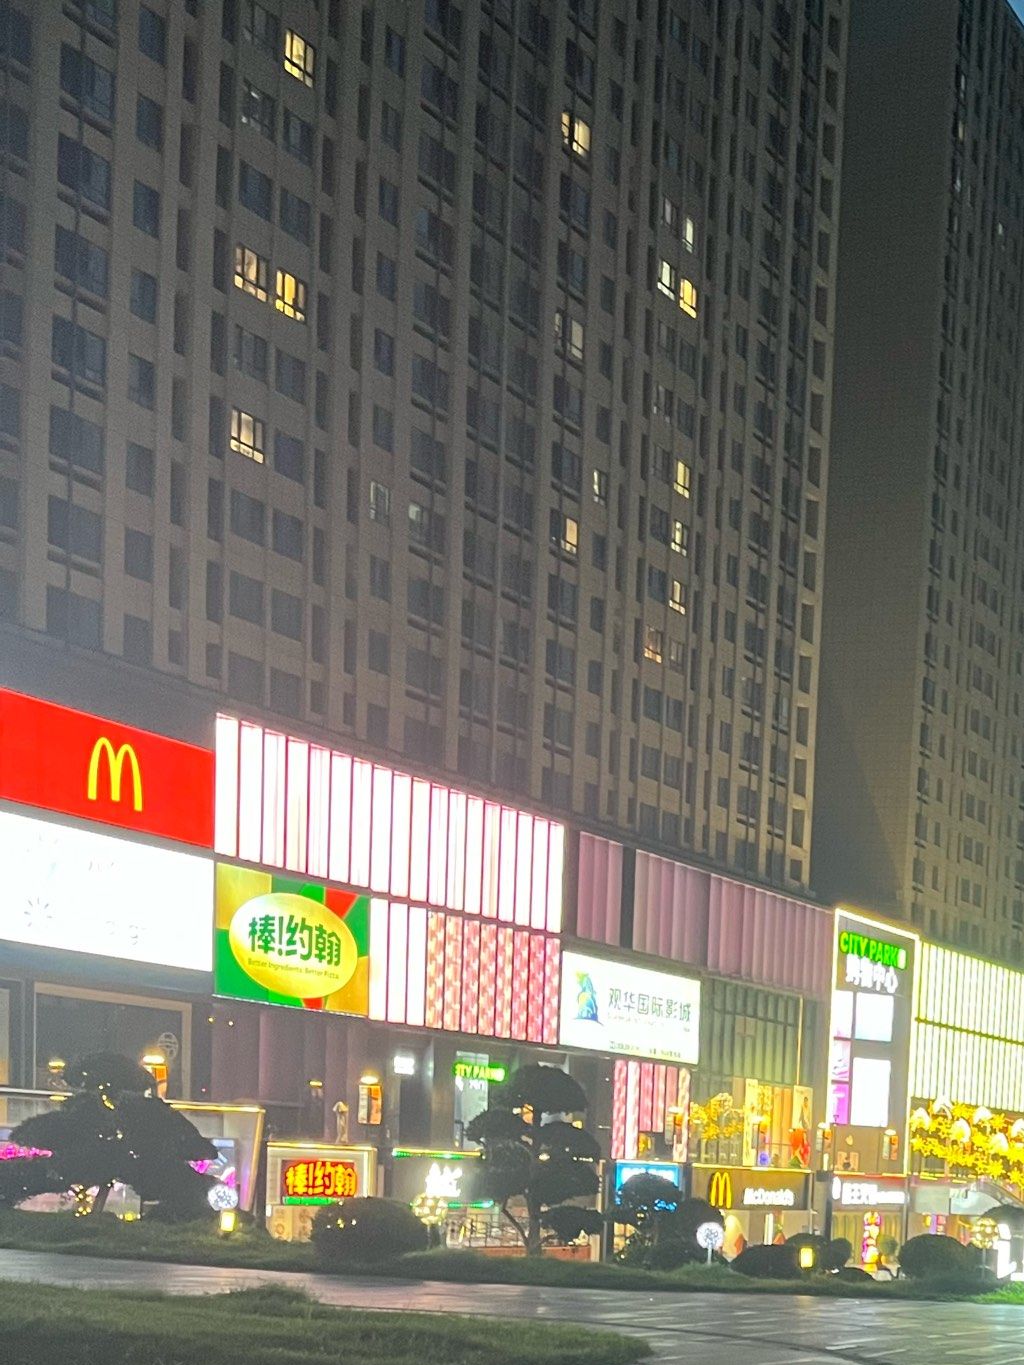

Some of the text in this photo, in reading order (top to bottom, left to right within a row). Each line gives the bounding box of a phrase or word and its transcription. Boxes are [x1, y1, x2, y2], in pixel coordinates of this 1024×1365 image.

[247, 913, 342, 967] 棒!约翰
[840, 932, 898, 967] CITY PARK
[608, 987, 692, 1023] 观华国际影城
[285, 1161, 357, 1196] 棒!约翰
